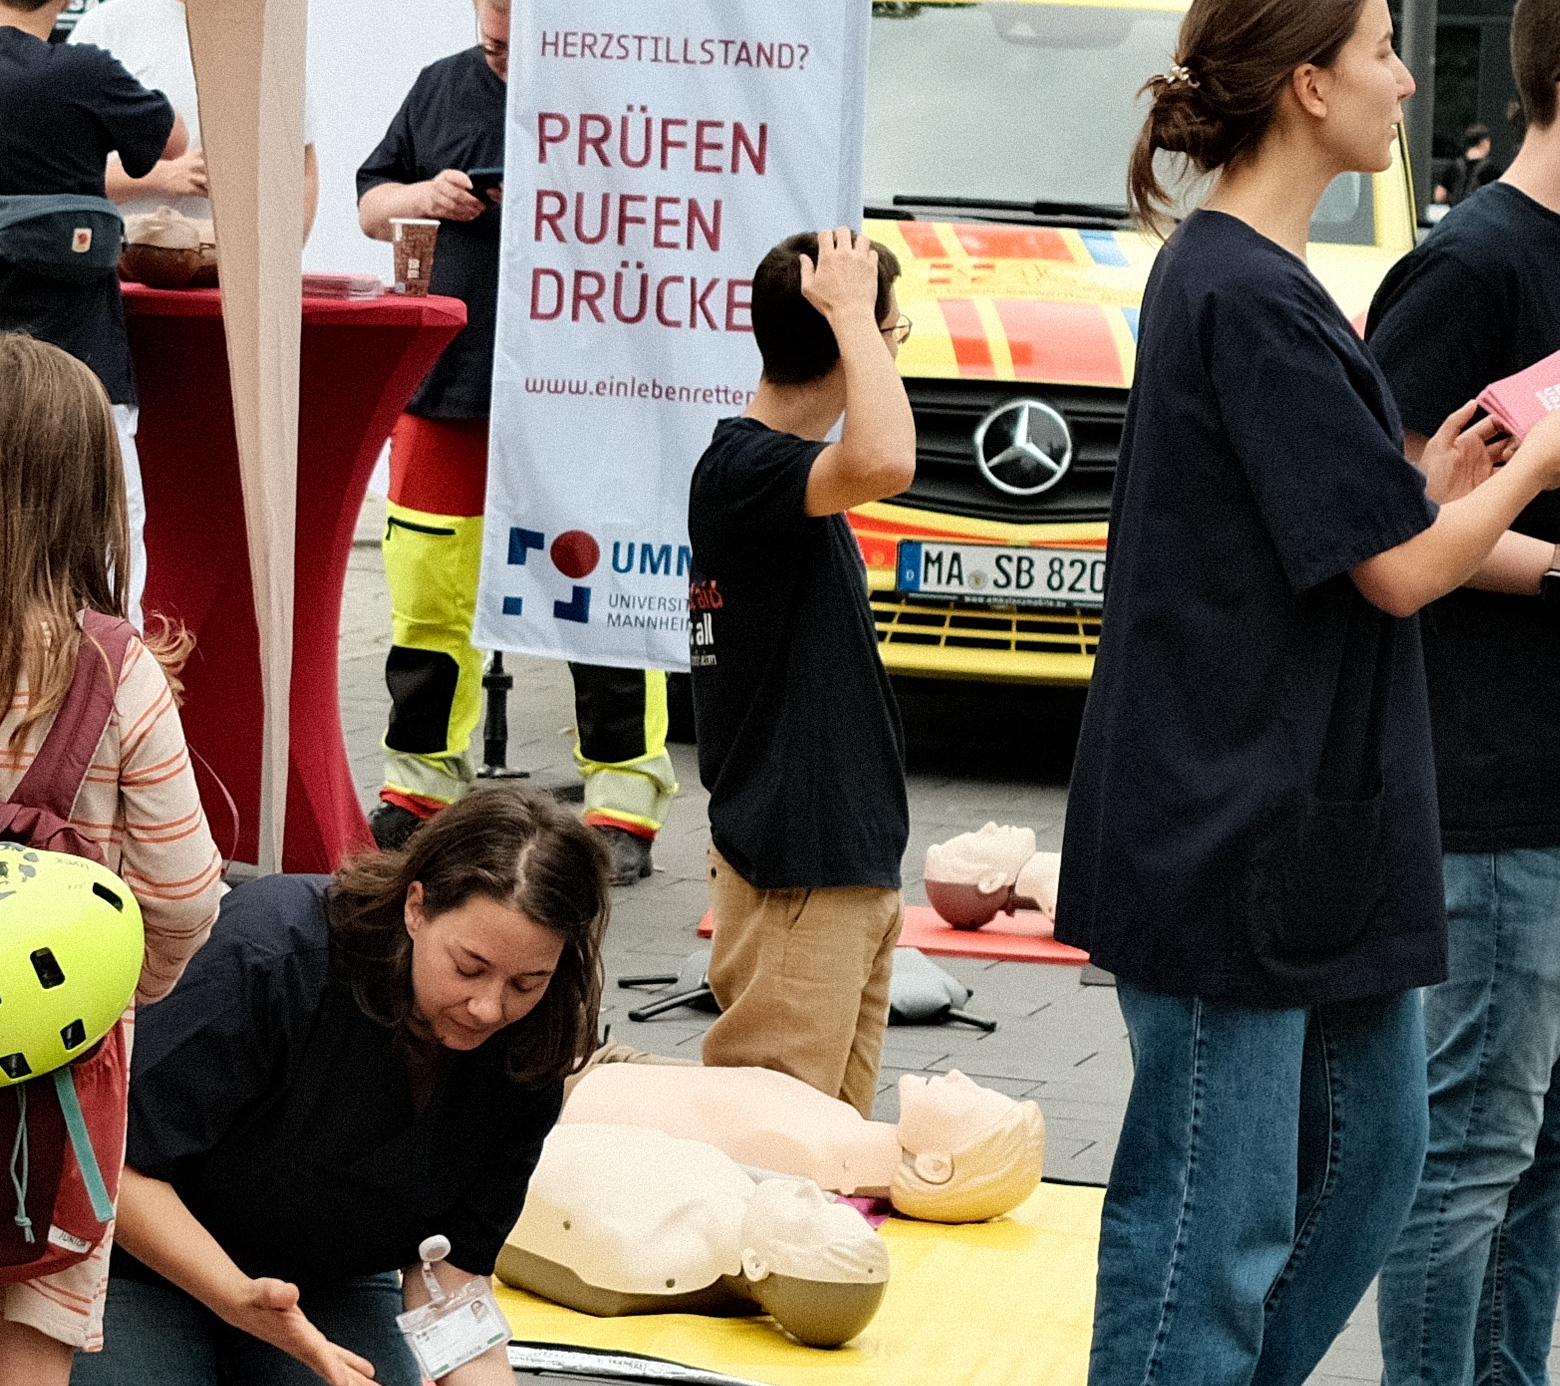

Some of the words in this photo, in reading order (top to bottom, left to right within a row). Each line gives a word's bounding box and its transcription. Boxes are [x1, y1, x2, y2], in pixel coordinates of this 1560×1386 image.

[541, 30, 810, 70] HERZSTILLSTAND?
[537, 104, 768, 175] PRÜFEN
[534, 189, 723, 251] RUFEN
[923, 550, 964, 586] MA
[993, 554, 1035, 590] SB
[696, 613, 724, 646] all
